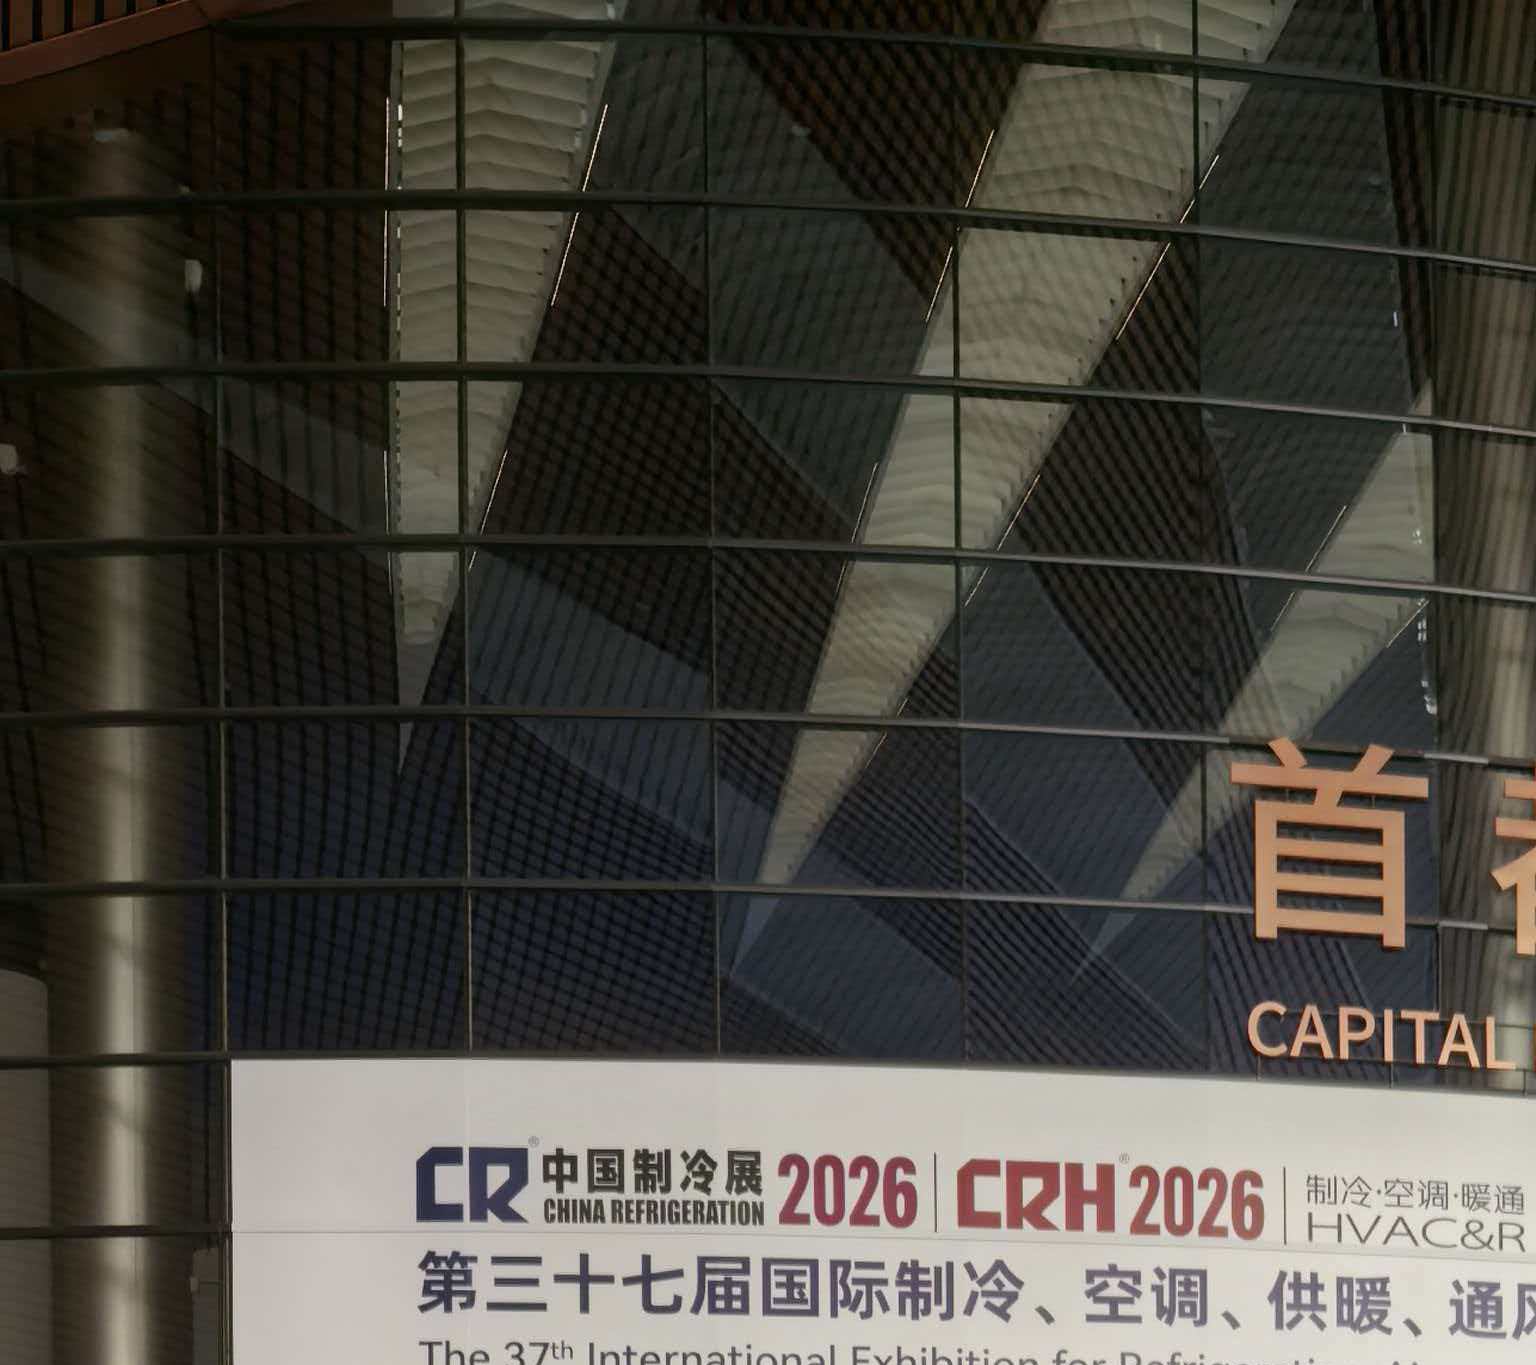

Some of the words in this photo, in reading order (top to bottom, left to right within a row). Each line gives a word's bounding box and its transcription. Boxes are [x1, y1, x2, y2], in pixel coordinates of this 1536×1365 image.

[1246, 999, 1515, 1073] CAPITAL
[416, 1146, 529, 1223] CR
[542, 1148, 763, 1197] 中国制冷展
[778, 1154, 918, 1227] 2026
[956, 1158, 1116, 1232] CRH
[1129, 1167, 1264, 1240] 2026
[544, 1198, 604, 1224] CHINA
[611, 1199, 764, 1226] REFRIGERATION
[1306, 1215, 1525, 1253] HVAC&R
